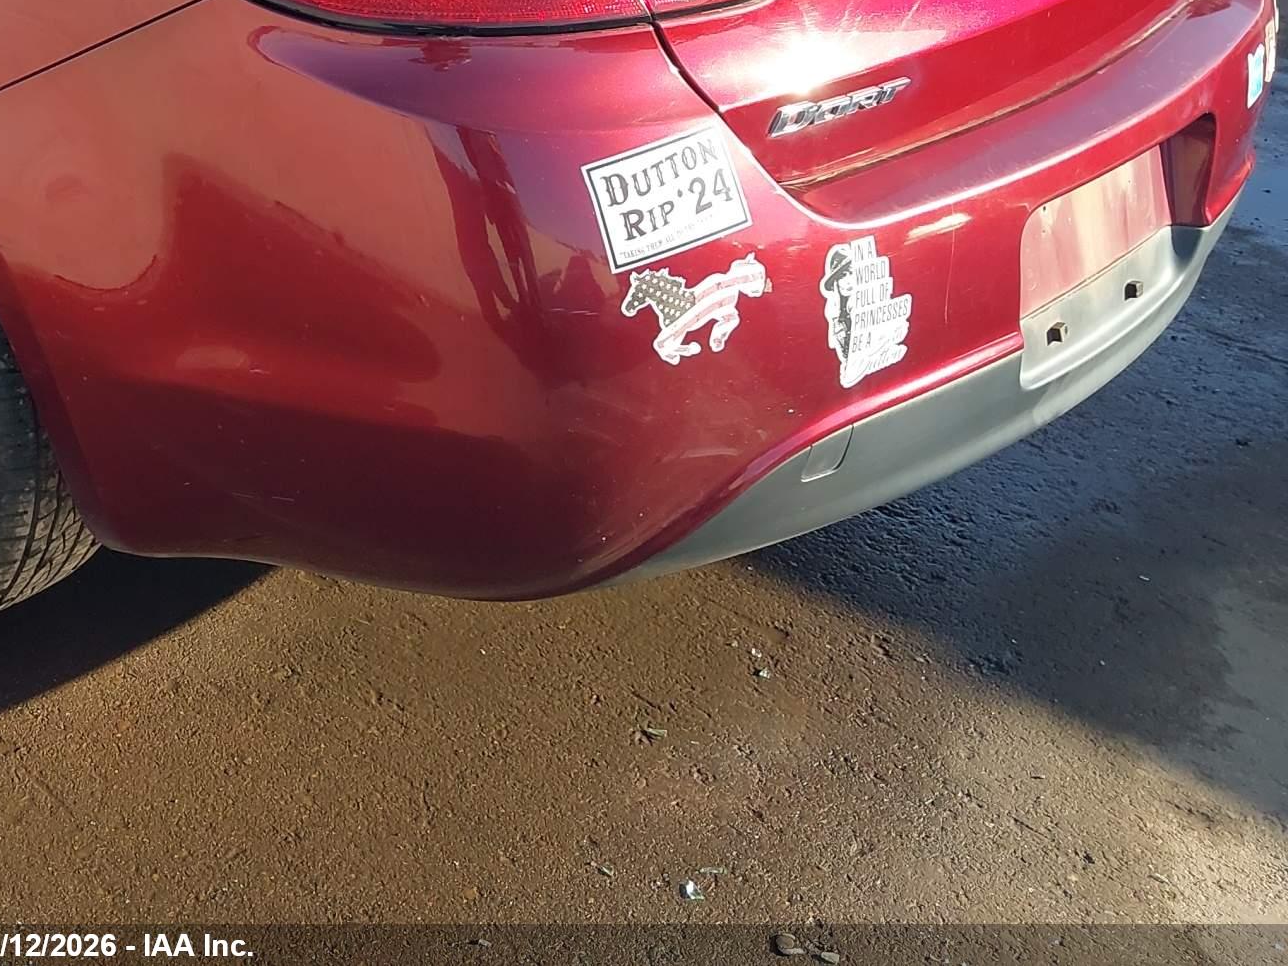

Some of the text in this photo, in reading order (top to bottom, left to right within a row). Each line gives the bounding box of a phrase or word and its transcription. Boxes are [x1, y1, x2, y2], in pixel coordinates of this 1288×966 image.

[600, 138, 719, 208] DUTTON
[854, 240, 875, 263] IN A
[855, 260, 886, 286] WORLD
[855, 281, 890, 308] FULL OF
[854, 298, 909, 331] PRINCESSES
[851, 334, 863, 354] BE
[864, 331, 872, 348] A
